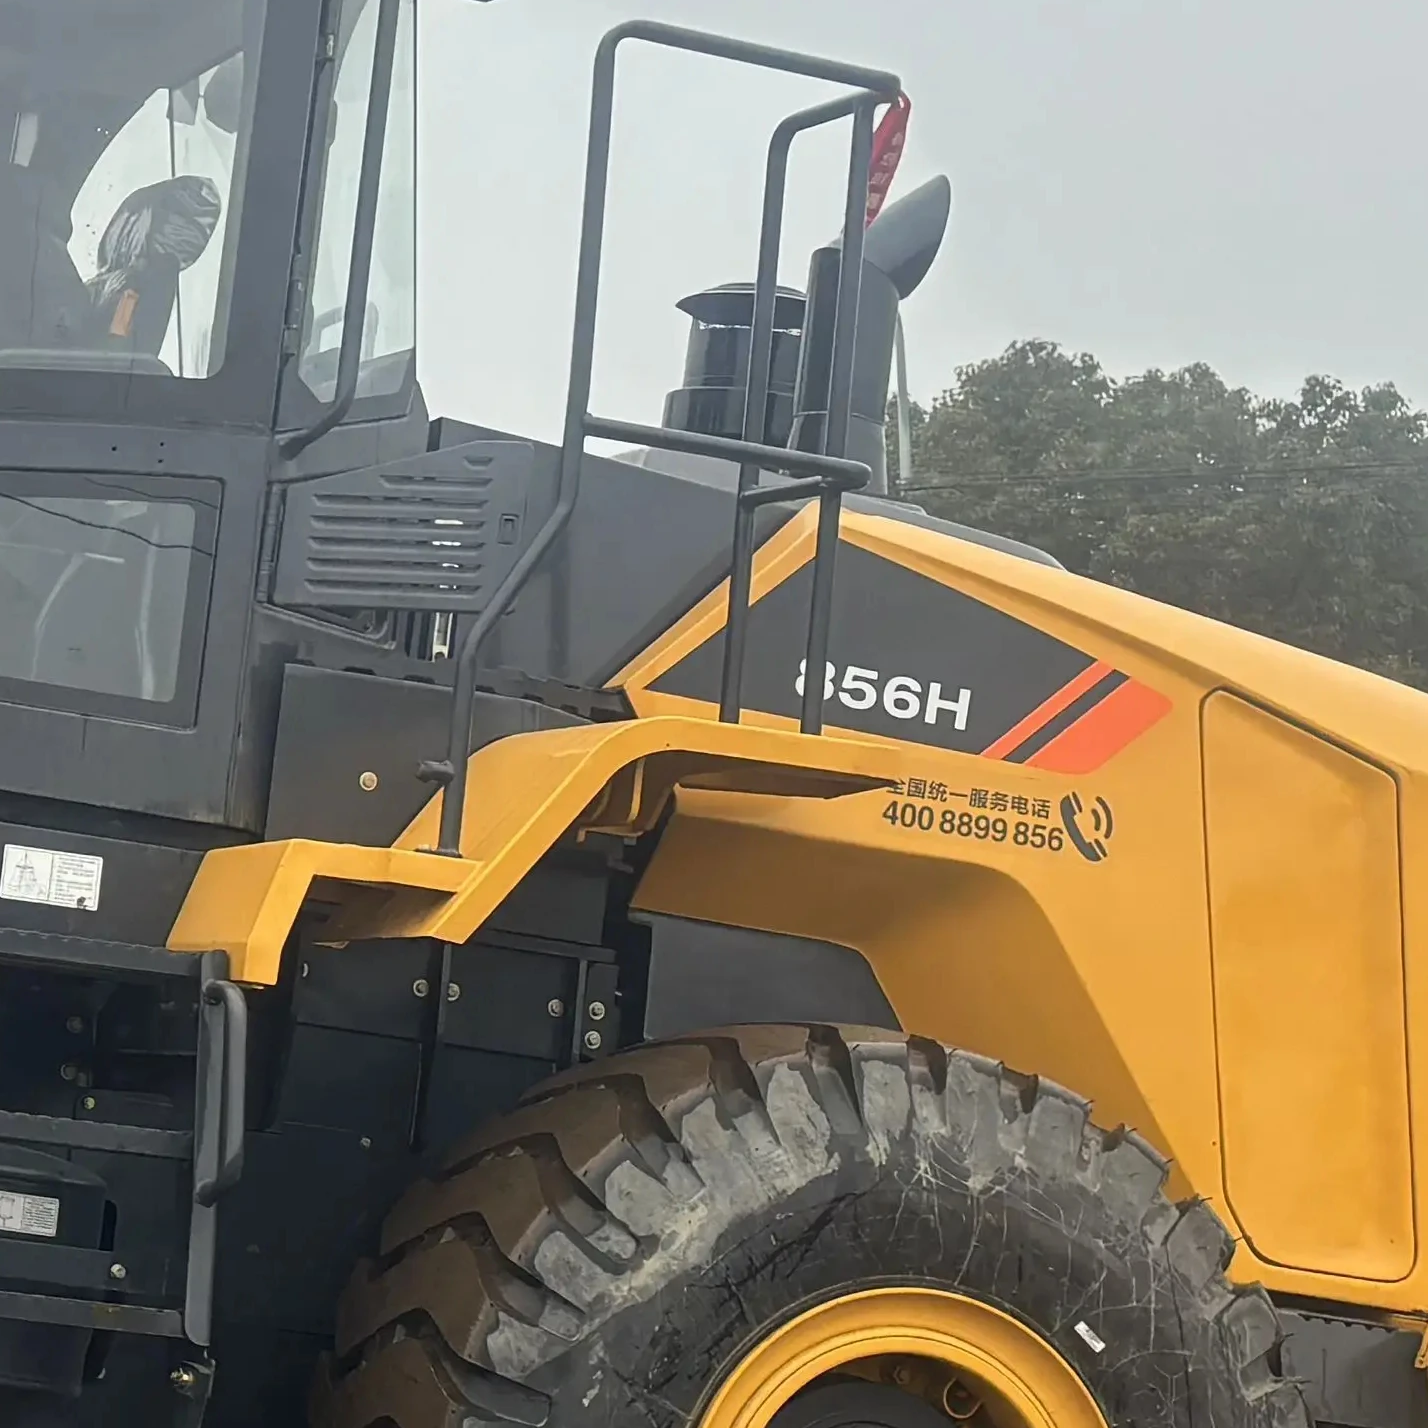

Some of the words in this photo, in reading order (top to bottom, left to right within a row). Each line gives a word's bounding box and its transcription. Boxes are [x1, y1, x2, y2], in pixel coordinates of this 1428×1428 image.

[795, 658, 972, 731] 856H
[886, 777, 1051, 820] 全国统一服务电话
[882, 800, 935, 831] 400
[939, 809, 1008, 843] 8899
[1012, 820, 1064, 852] 856
